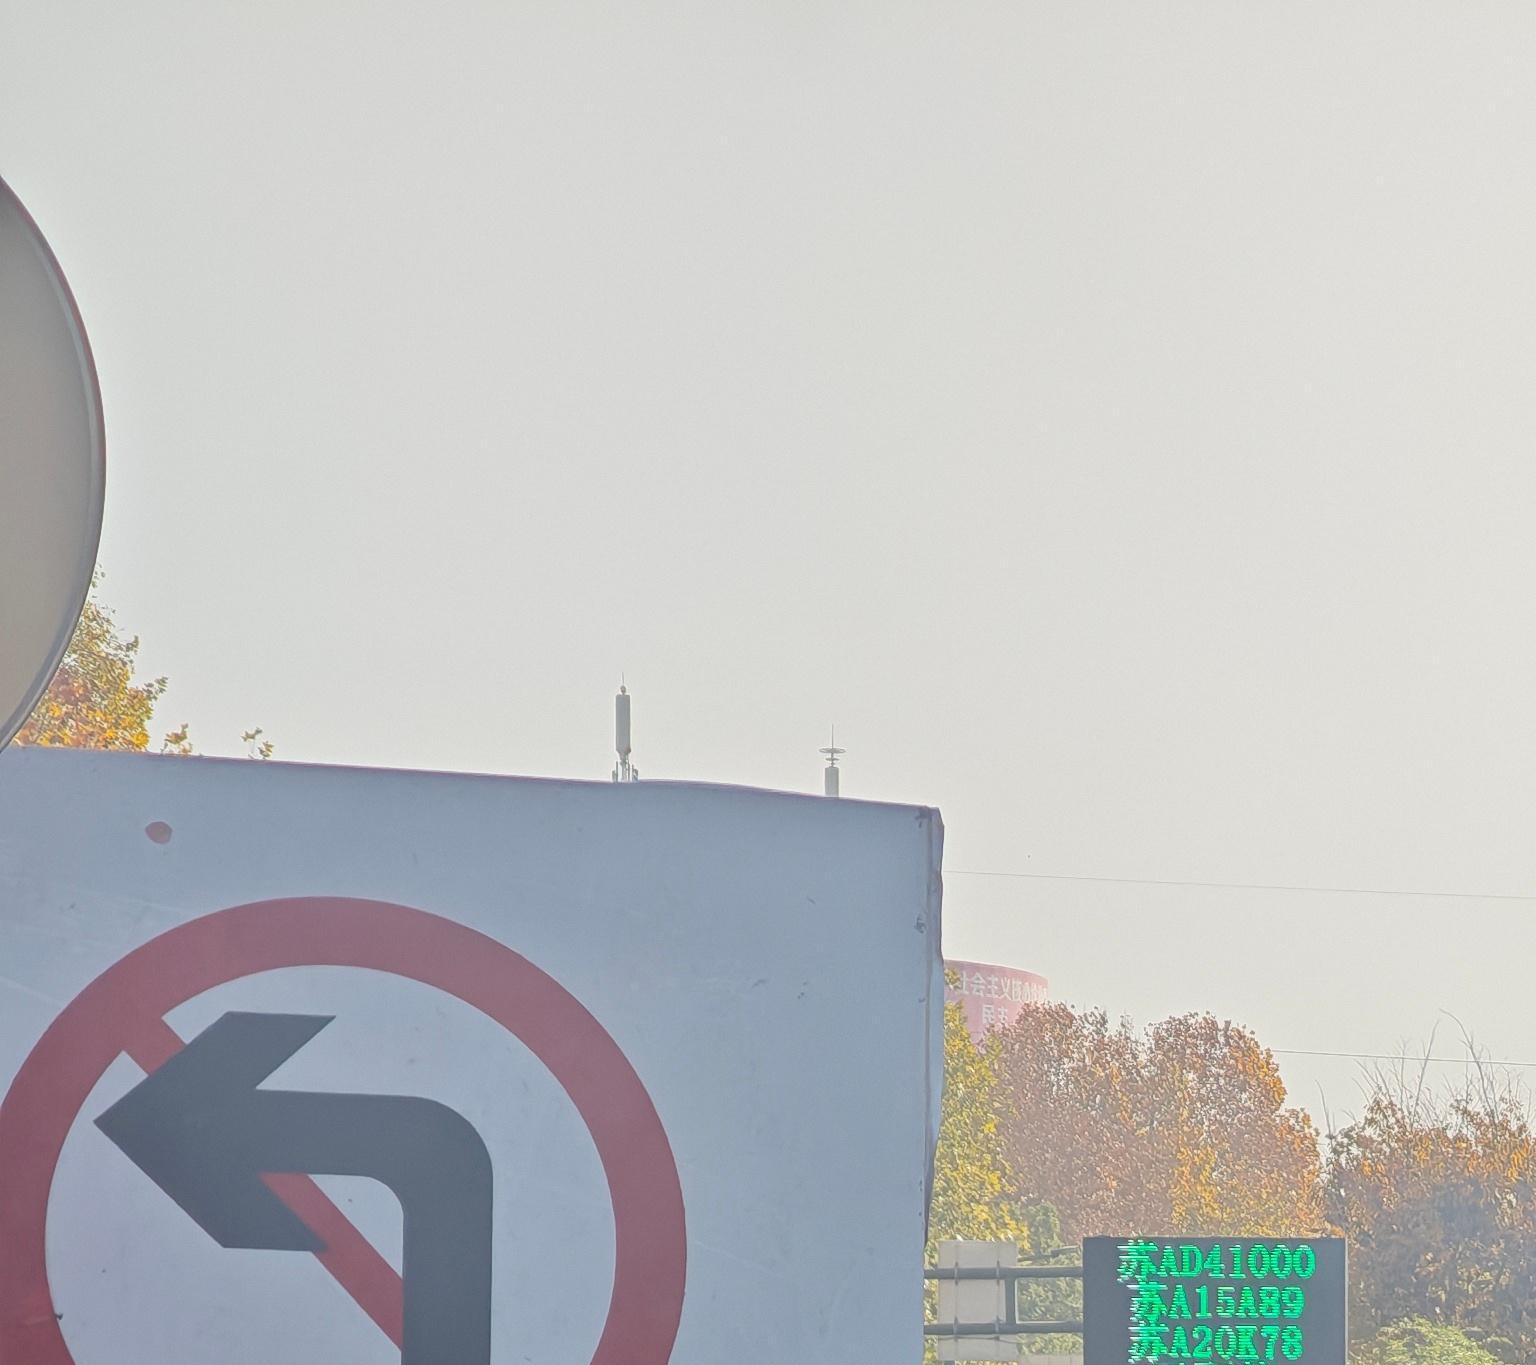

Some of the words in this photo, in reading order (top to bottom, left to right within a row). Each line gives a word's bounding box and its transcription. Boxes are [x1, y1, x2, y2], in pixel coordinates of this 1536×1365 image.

[1117, 1241, 1316, 1281] 苏AD41000
[1127, 1283, 1306, 1321] 苏A15A89
[1128, 1323, 1304, 1362] 苏A20K78
